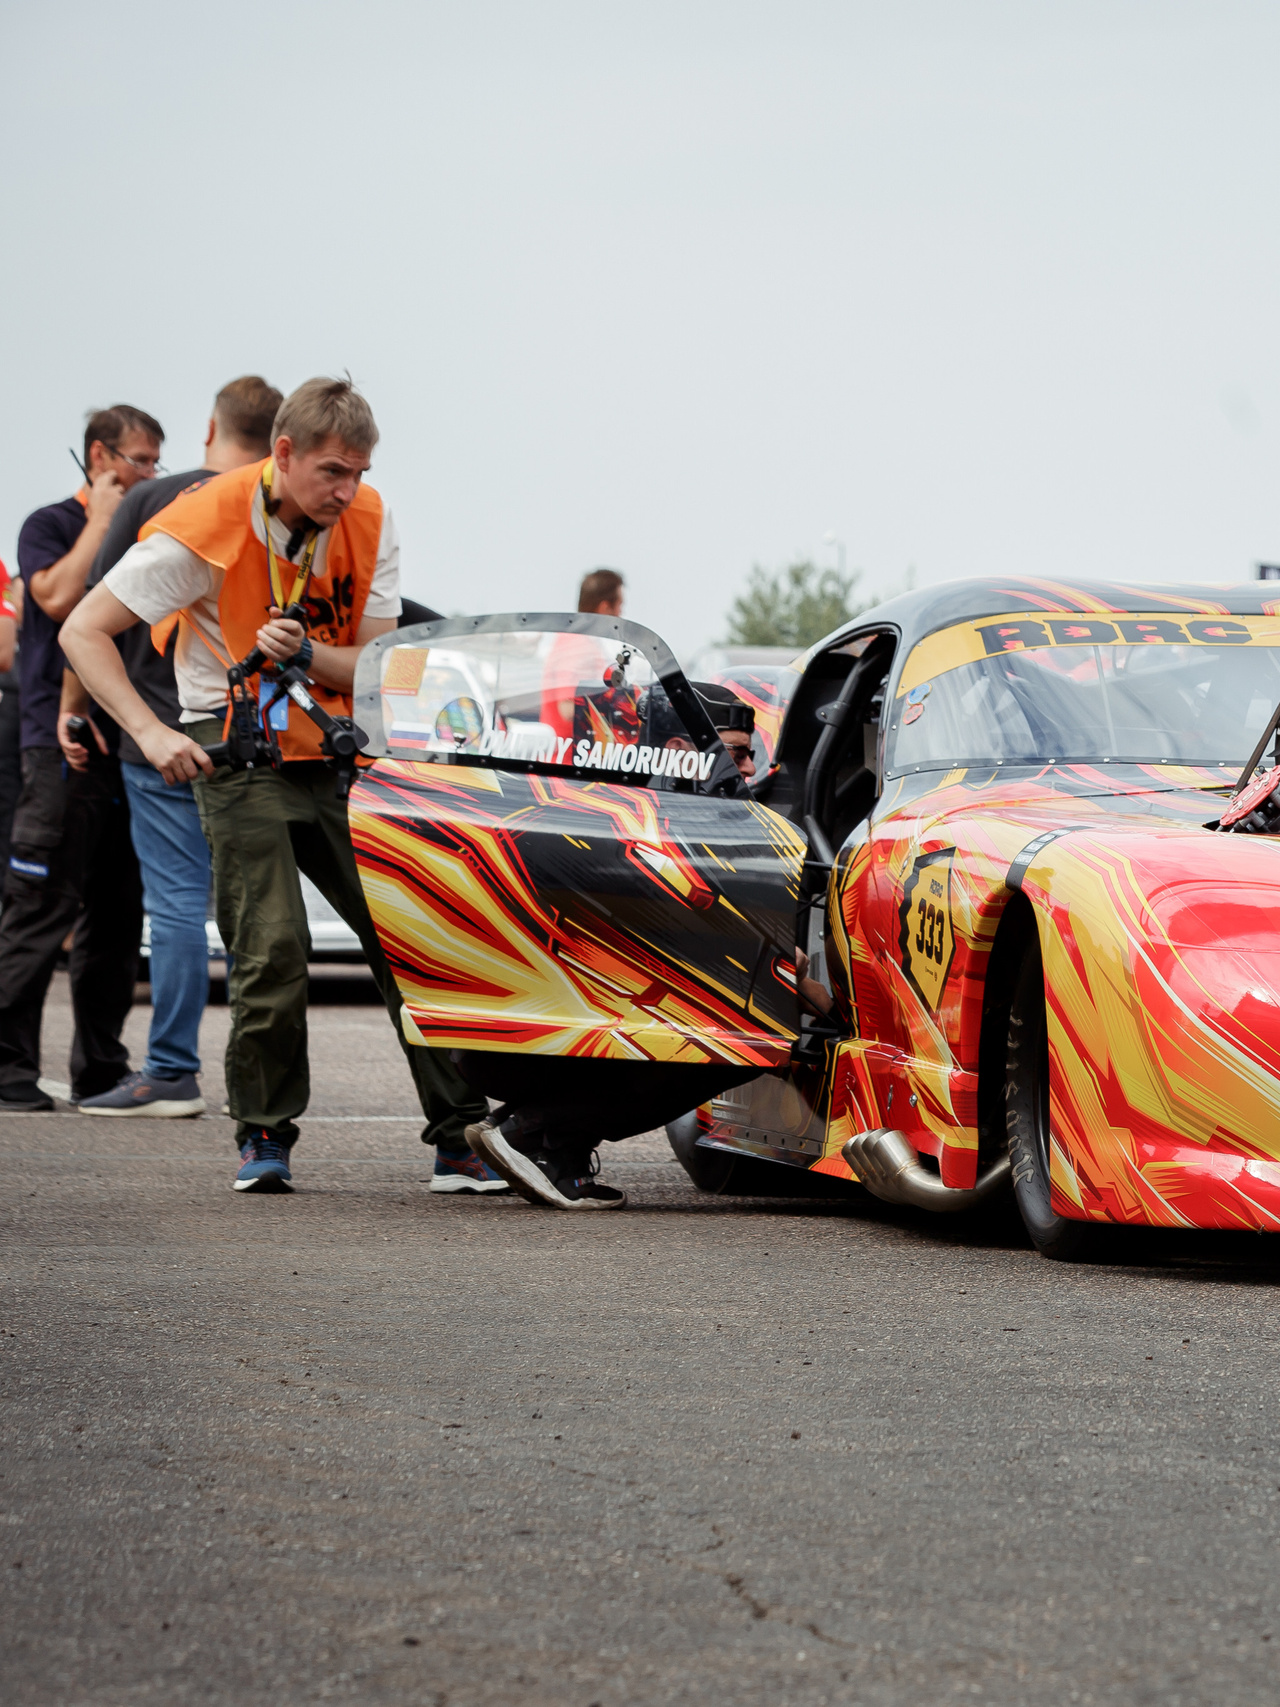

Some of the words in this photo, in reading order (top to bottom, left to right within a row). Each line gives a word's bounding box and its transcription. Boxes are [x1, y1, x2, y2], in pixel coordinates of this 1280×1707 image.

[974, 620, 1253, 655] RDRC
[478, 729, 573, 765] DMITRIY
[573, 739, 716, 780] SAMORUKOV
[915, 897, 945, 966] 333
